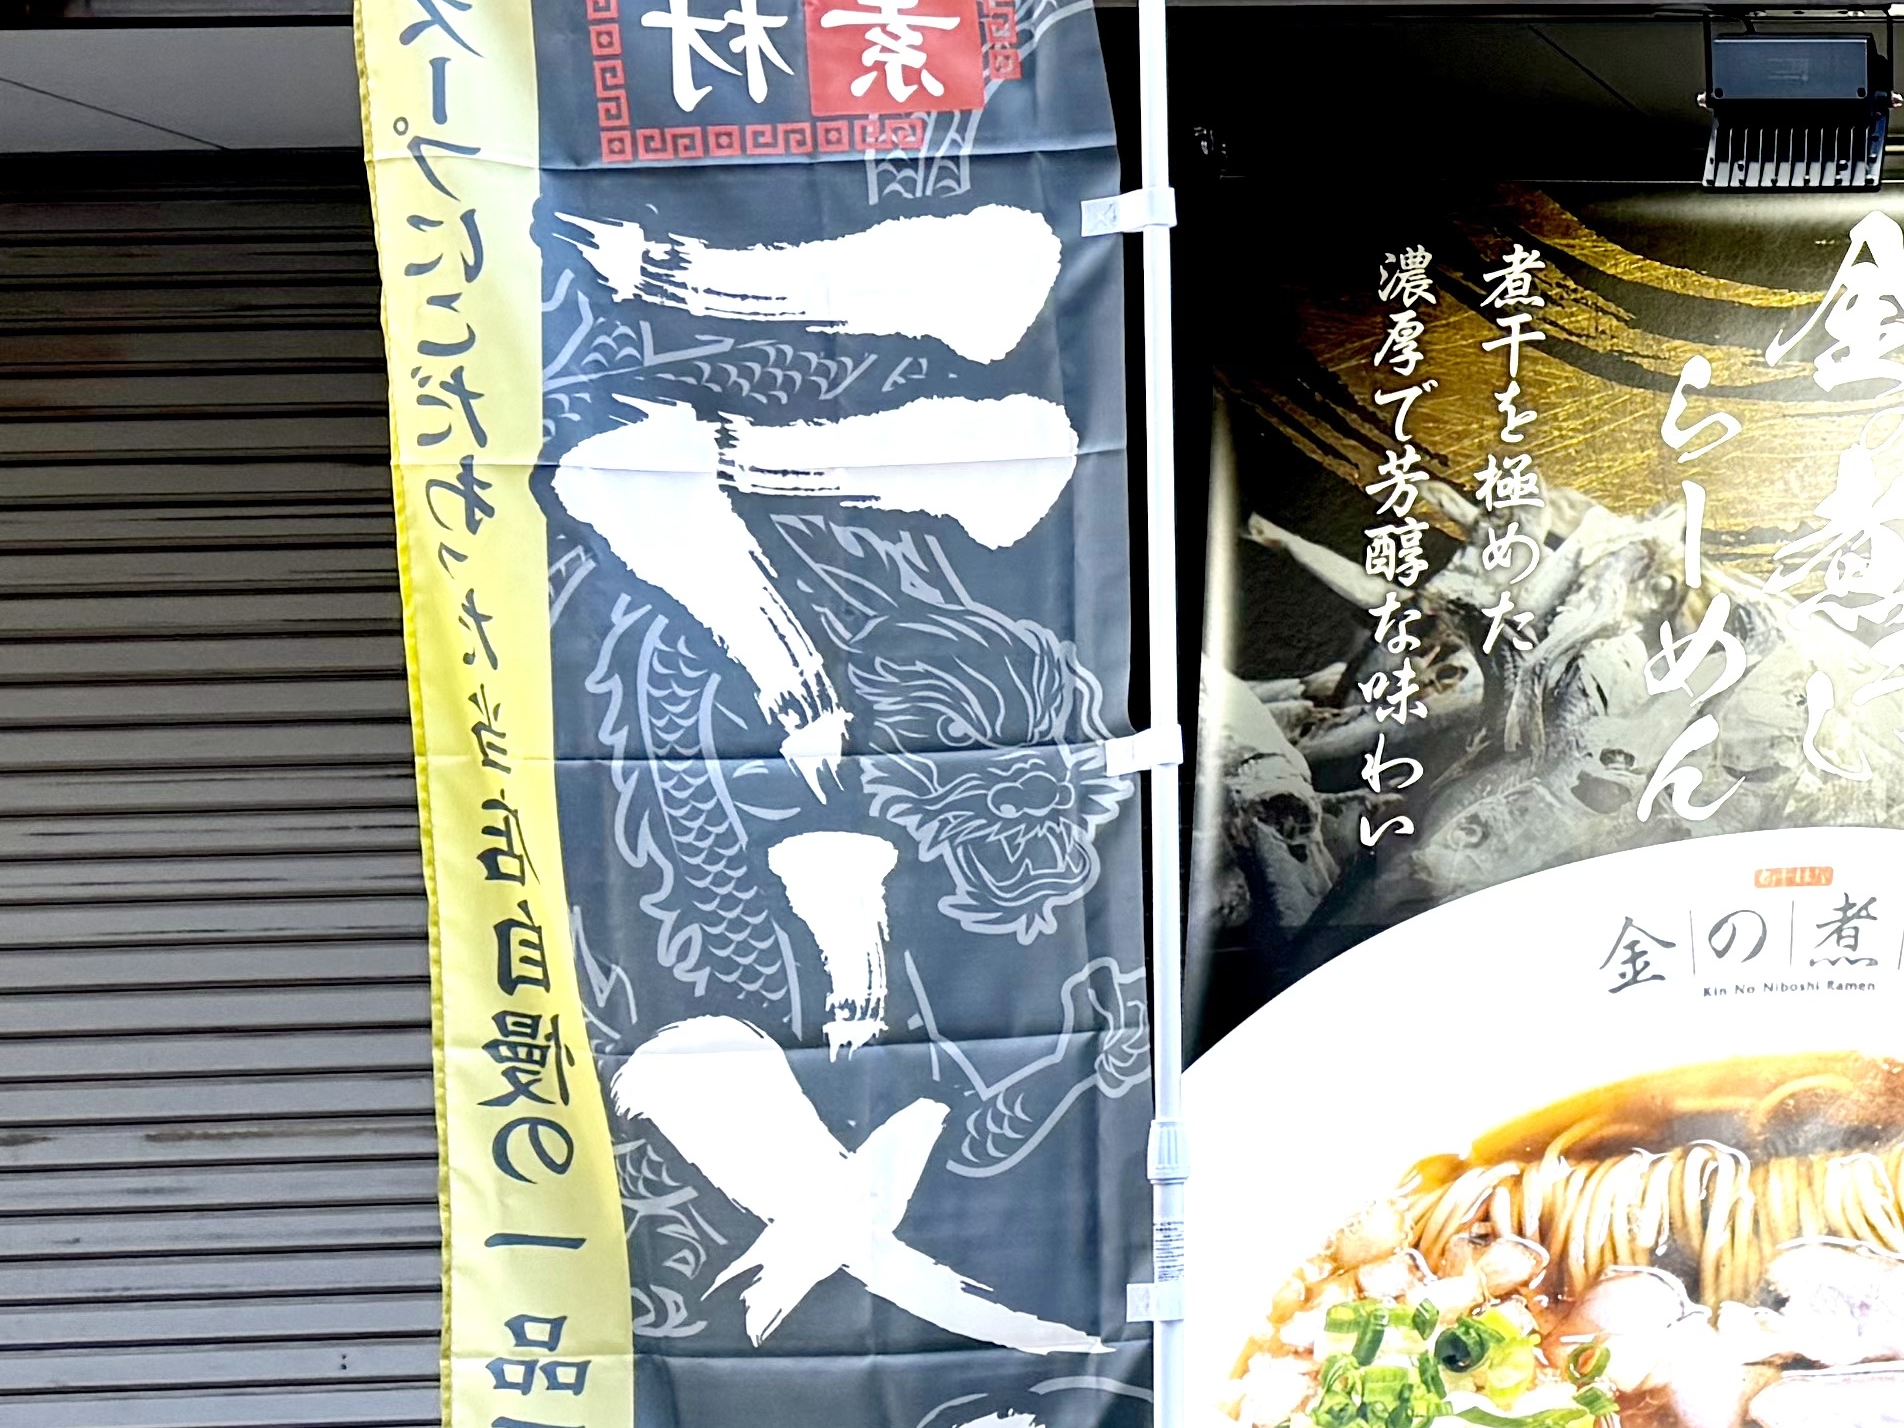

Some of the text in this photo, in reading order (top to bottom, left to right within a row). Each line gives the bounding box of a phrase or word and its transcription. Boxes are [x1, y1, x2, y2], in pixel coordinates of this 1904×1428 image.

[1356, 246, 1435, 856] 濃厚で芳醇な味わい
[1472, 242, 1548, 656] 煮干を極めた
[1637, 352, 1749, 824] らーめん
